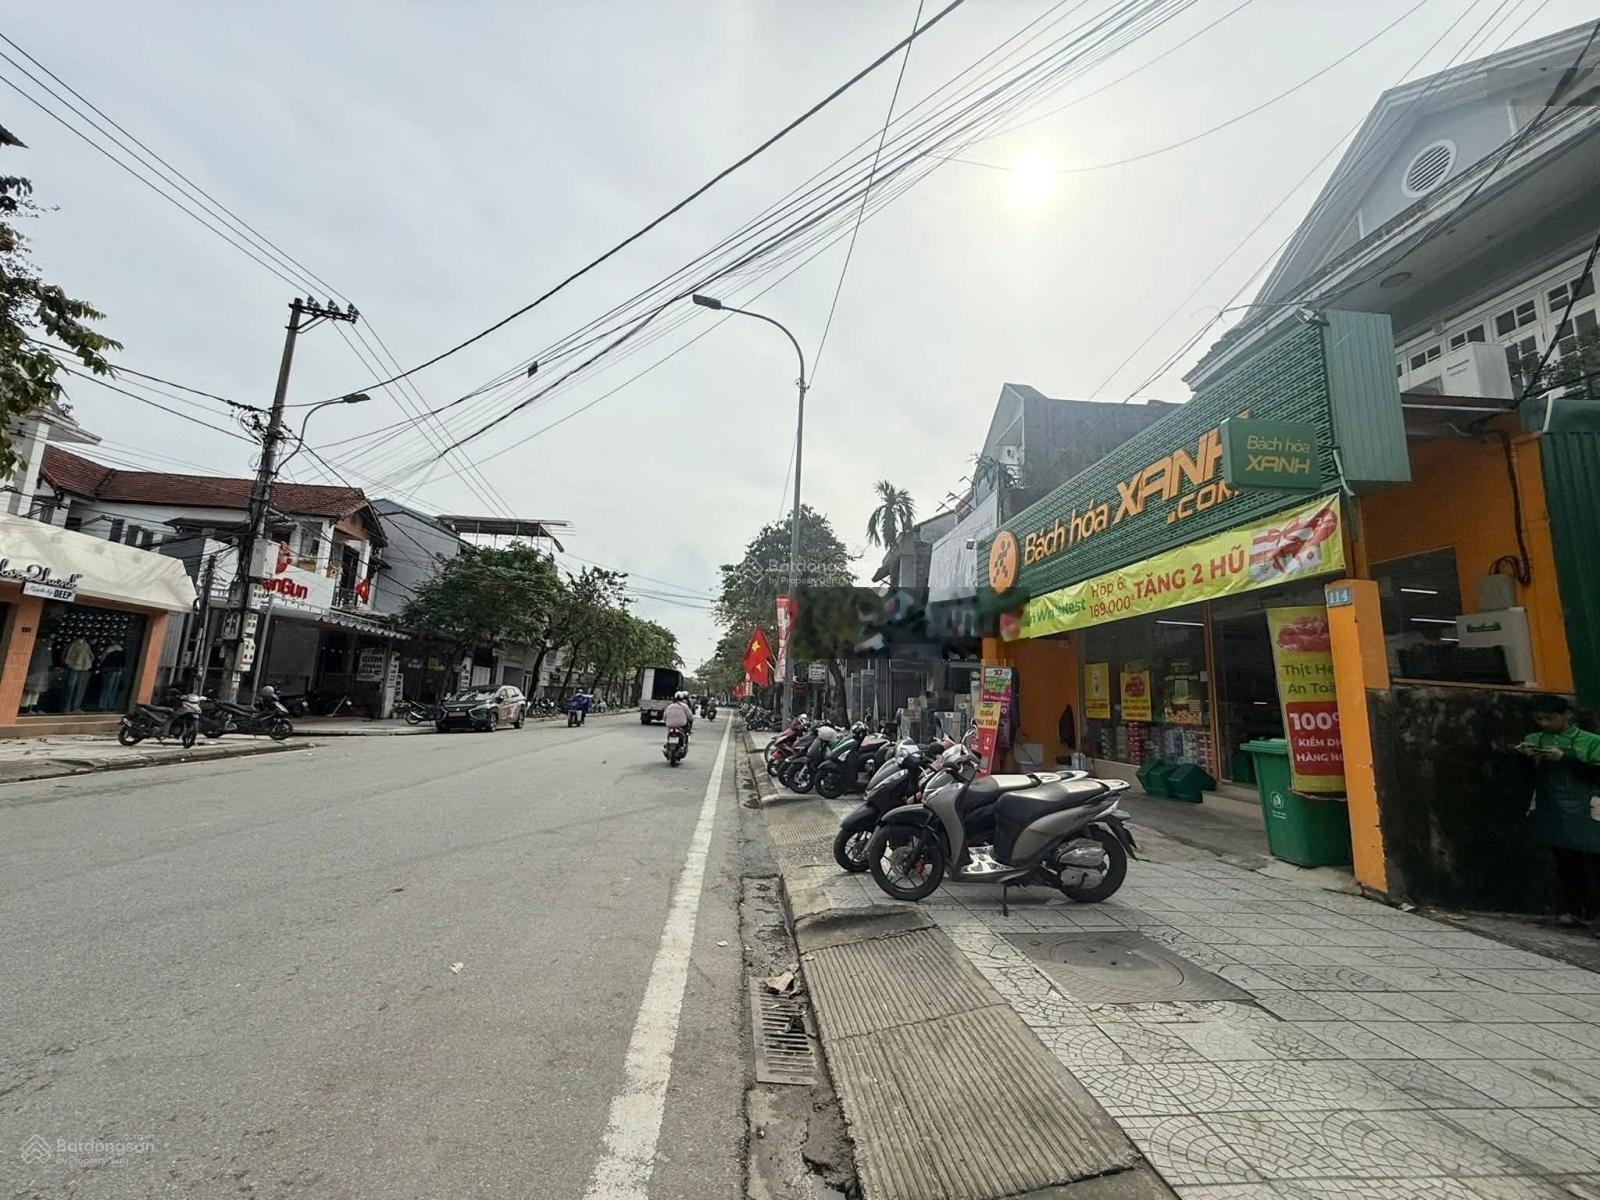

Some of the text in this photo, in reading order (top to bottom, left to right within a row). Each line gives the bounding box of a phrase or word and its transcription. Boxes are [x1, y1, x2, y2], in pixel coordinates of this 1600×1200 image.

[1246, 435, 1311, 452] Bách hóa
[1245, 454, 1312, 474] XANH
[1023, 517, 1066, 567] Bách
[1069, 500, 1110, 546] hóa
[1133, 569, 1186, 602] TẶNG
[1192, 562, 1204, 586] 2
[1210, 549, 1245, 584] HŨ
[53, 589, 73, 600] DEEP
[1329, 591, 1349, 604] 114
[1282, 664, 1311, 678] Thịt
[1287, 684, 1306, 694] An
[1289, 711, 1340, 731] 100
[1296, 752, 1328, 762] HÀNG
